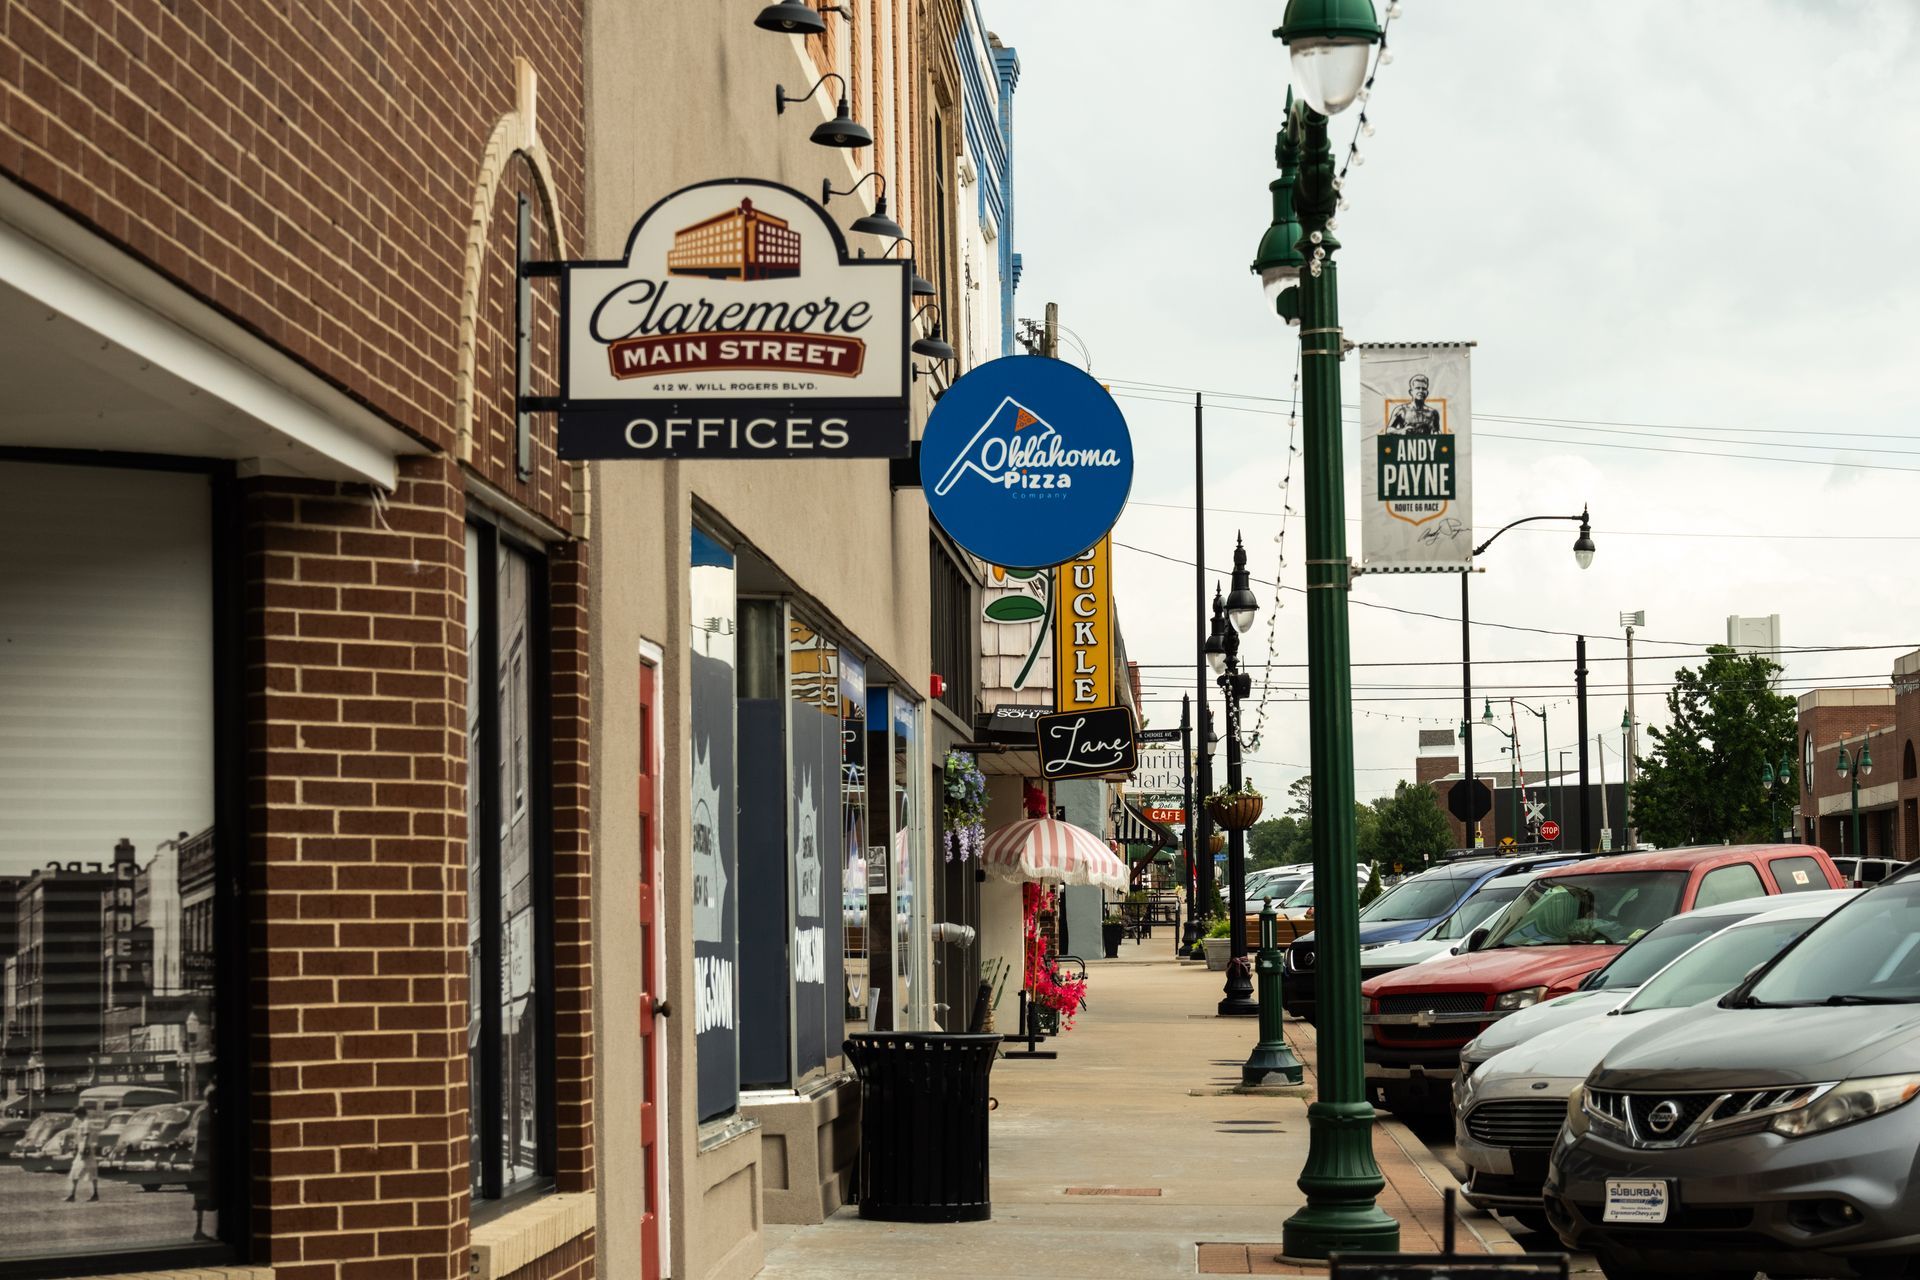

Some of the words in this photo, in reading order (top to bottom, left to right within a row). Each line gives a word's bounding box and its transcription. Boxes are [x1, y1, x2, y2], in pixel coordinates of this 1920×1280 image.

[589, 279, 873, 345] Claremore
[622, 342, 708, 369] MAIN
[718, 340, 848, 367] STREET
[652, 383, 675, 392] 412
[677, 383, 692, 391] W.
[697, 383, 727, 391] WILL
[730, 382, 779, 391] ROGERS
[782, 382, 818, 391] BLVD.
[624, 418, 850, 450] OFFICES
[981, 434, 1121, 472] Oklahoma
[1397, 439, 1437, 461] ANDY
[1004, 468, 1072, 489] Pizza
[1383, 463, 1450, 497] PAYNE
[1012, 491, 1068, 500] Company
[1394, 503, 1414, 512] ROUTE
[1414, 503, 1423, 512] 66
[1424, 502, 1439, 512] RACE
[1045, 717, 1131, 773] Lane
[1152, 810, 1181, 821] CAFE
[1541, 826, 1559, 835] STOP
[1610, 1188, 1662, 1197] SUBURBAN
